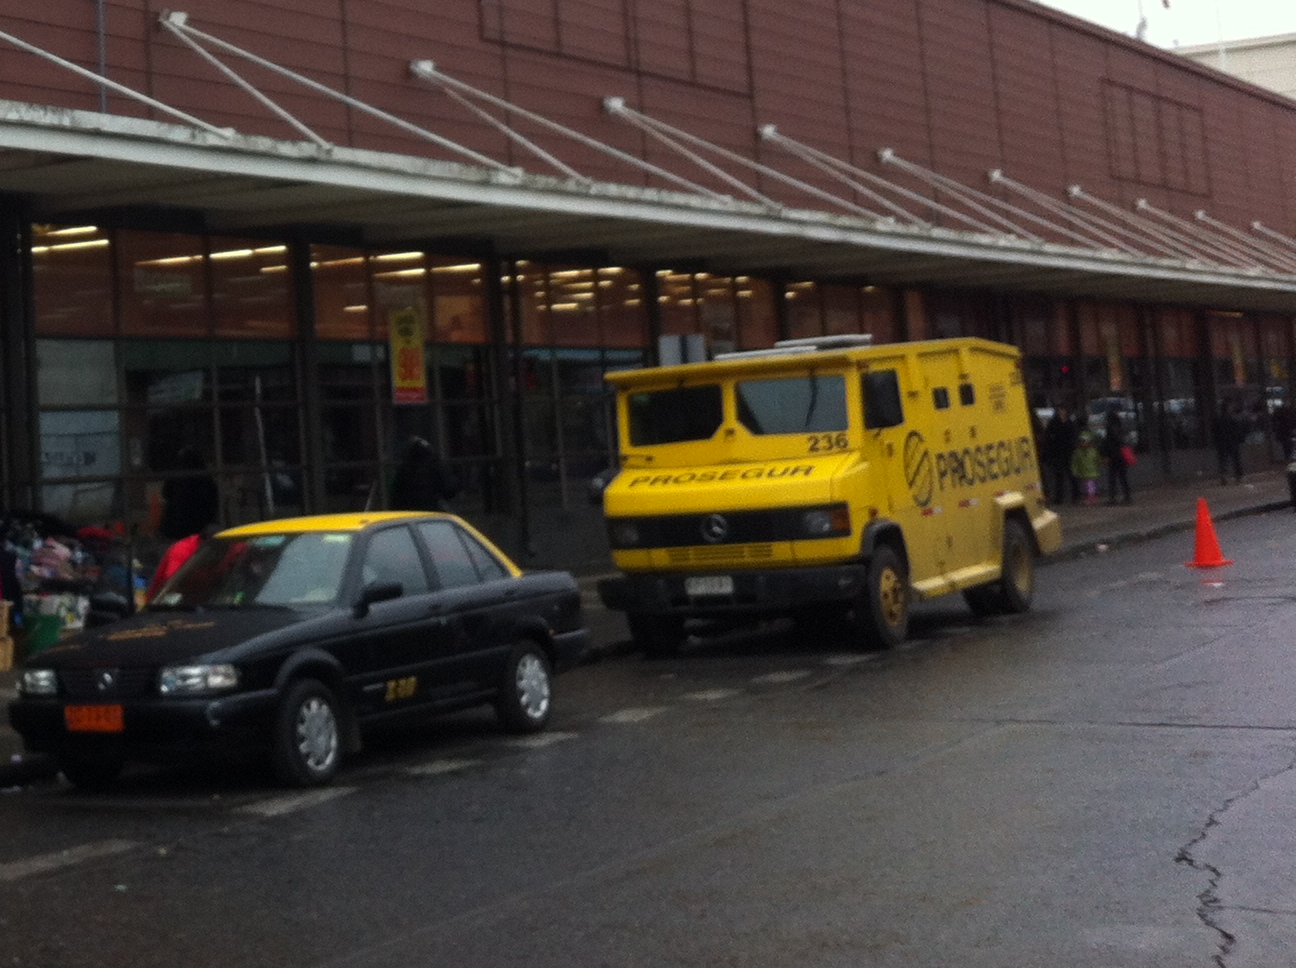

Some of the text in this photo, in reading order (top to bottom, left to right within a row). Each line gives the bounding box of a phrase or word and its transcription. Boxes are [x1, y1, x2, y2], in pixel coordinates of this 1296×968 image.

[807, 433, 849, 453] 236
[628, 463, 817, 489] PROSEGUR
[934, 434, 1038, 492] PROSEGUR
